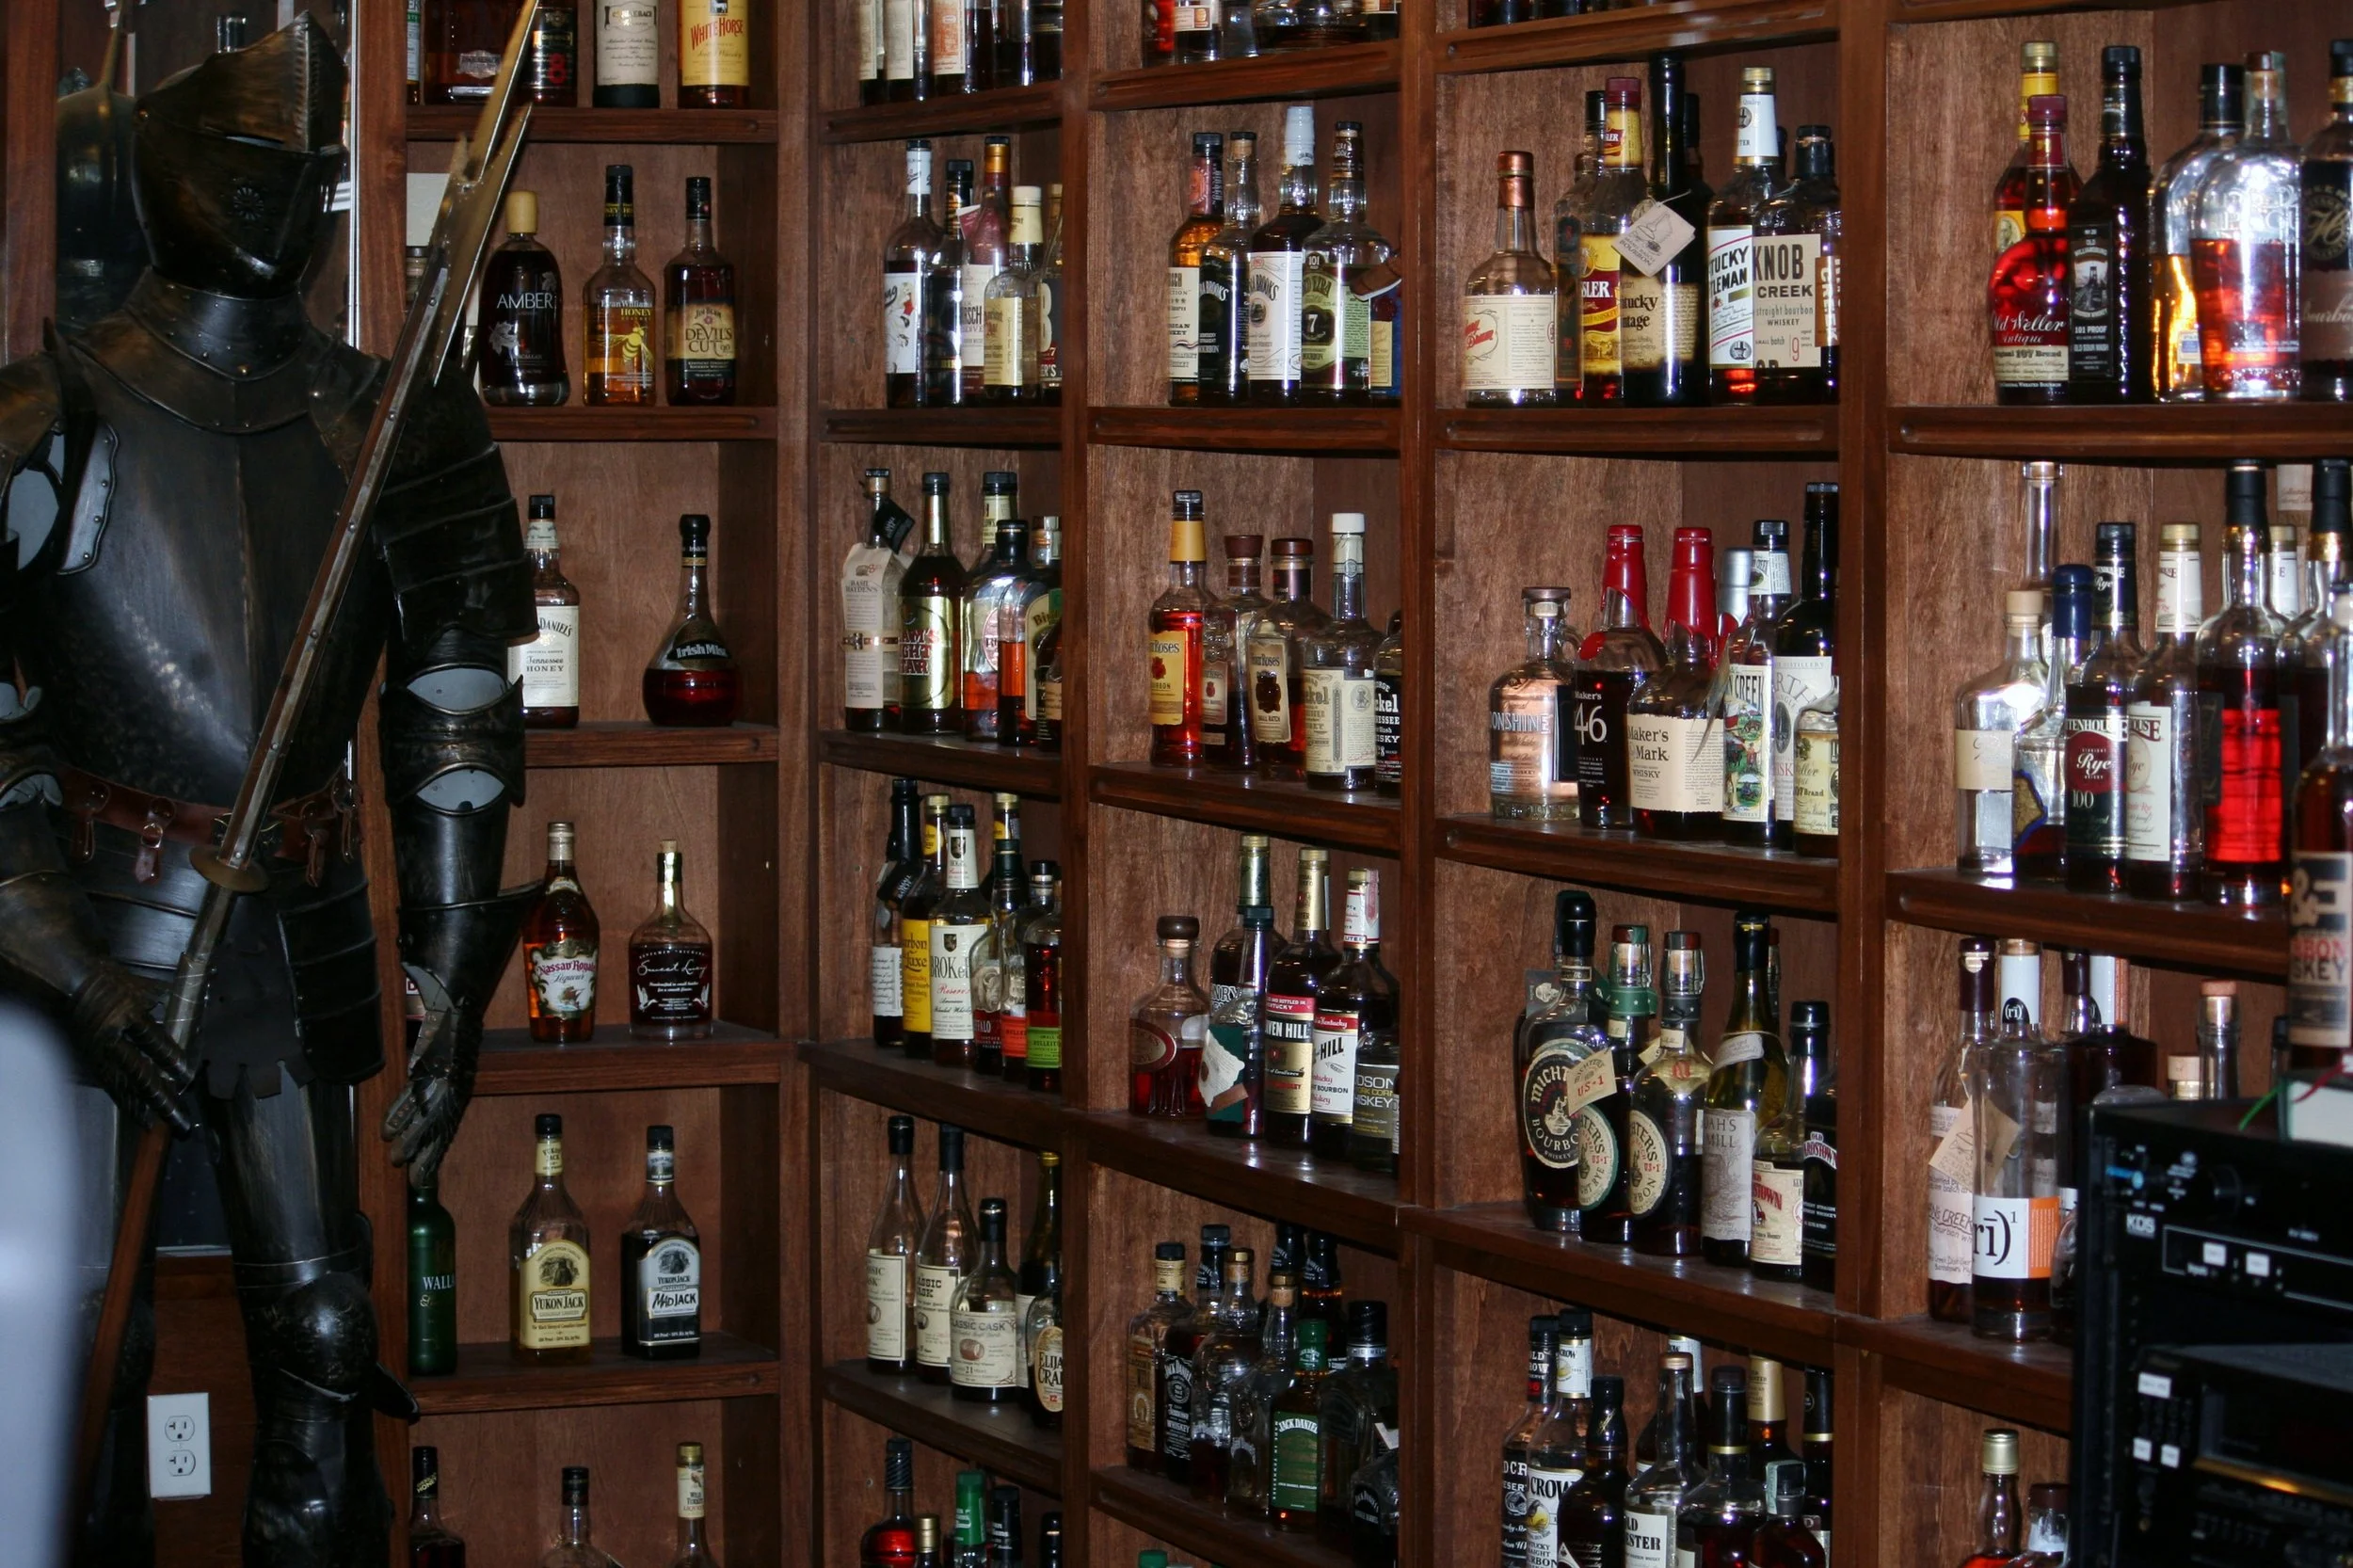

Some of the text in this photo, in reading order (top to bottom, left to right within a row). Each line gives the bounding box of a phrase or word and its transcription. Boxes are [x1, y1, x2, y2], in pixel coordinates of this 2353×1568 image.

[691, 17, 744, 50] WHITE HORSE
[1308, 256, 1320, 265] 101
[1754, 244, 1804, 280] KNOB
[1757, 284, 1813, 297] CREEK
[496, 293, 553, 309] AMBER
[620, 308, 651, 316] HONEY
[1756, 303, 1814, 318] straight bourbon
[1308, 314, 1318, 333] 7
[2010, 310, 2065, 331] Weller
[2074, 326, 2086, 334] 101
[688, 337, 722, 357] CUT
[1792, 337, 1800, 361] 9
[540, 616, 572, 639] DANIEL'S
[676, 646, 706, 659] Irish
[1574, 702, 1609, 745] 46
[1628, 725, 1670, 742] Maker's
[1636, 745, 1670, 760] Mark
[2076, 753, 2113, 776] Rye
[1632, 768, 1661, 778] WHISKY
[2073, 789, 2095, 809] 100
[1286, 1022, 1310, 1039] HILL
[1320, 1037, 1344, 1060] HILL
[1318, 1084, 1349, 1094] BOURBON
[1593, 1167, 1605, 1188] RYE
[535, 1295, 584, 1310] YUKON JACK
[674, 1291, 696, 1305] JACK
[1560, 1349, 1576, 1359] CROW
[1278, 1418, 1295, 1432] JACK
